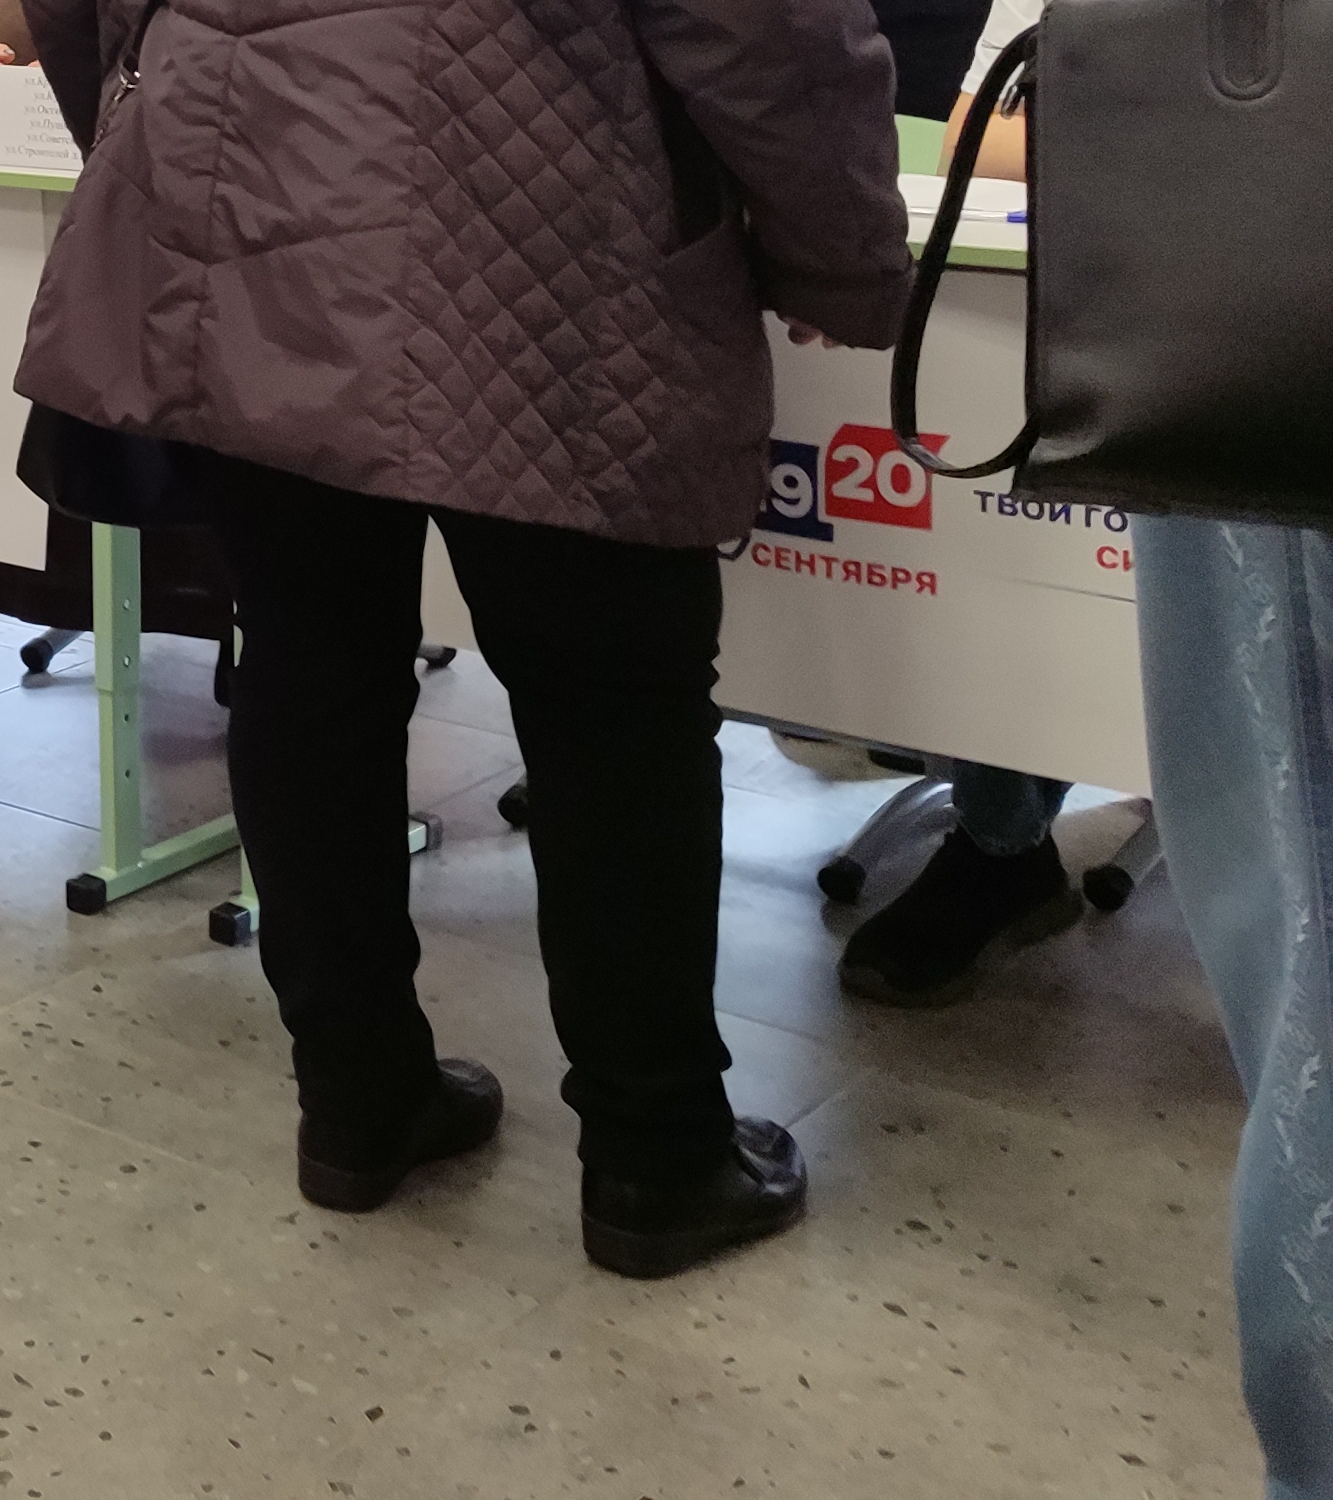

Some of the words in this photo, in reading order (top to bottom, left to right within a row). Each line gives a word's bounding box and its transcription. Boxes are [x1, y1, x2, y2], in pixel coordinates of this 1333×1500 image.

[760, 462, 813, 519] 9
[831, 444, 927, 508] 20
[751, 541, 938, 596] СЕНТЯБРЯ
